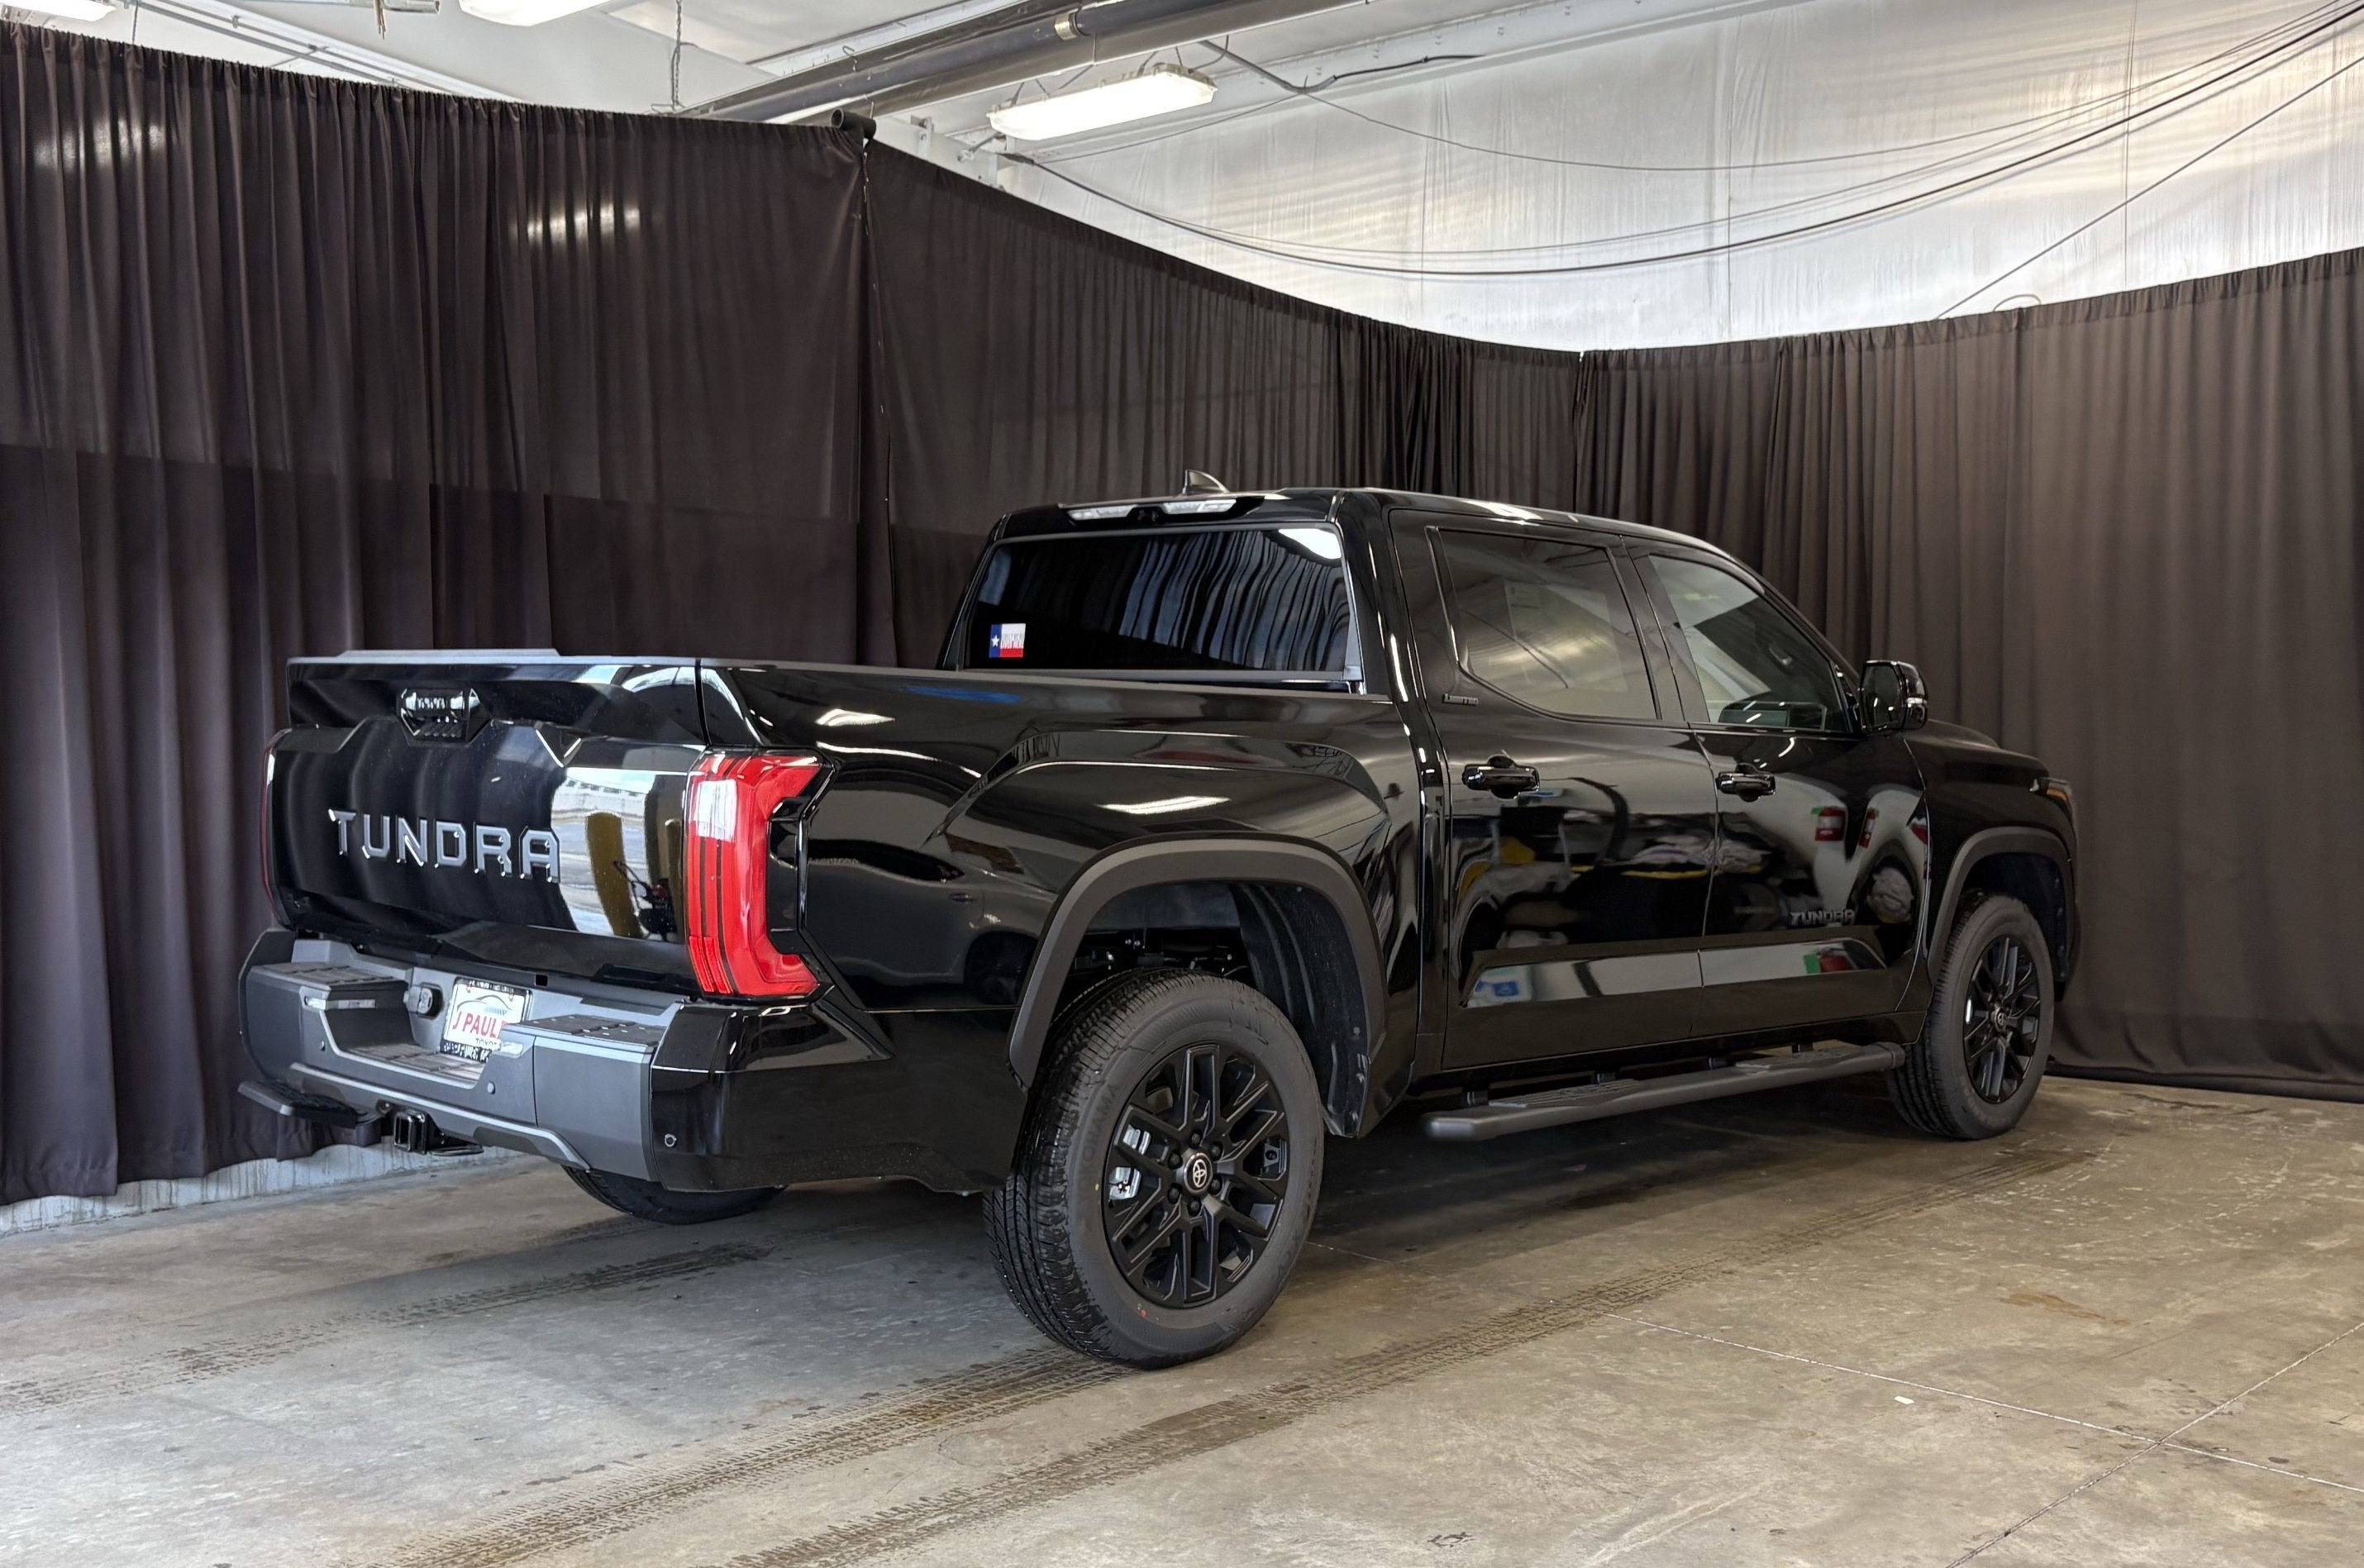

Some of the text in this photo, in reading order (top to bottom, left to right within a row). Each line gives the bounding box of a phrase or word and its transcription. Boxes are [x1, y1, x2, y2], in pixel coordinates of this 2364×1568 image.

[328, 809, 560, 884] TUNDRA
[1790, 909, 1856, 926] TUNDRA
[452, 1011, 463, 1030] J
